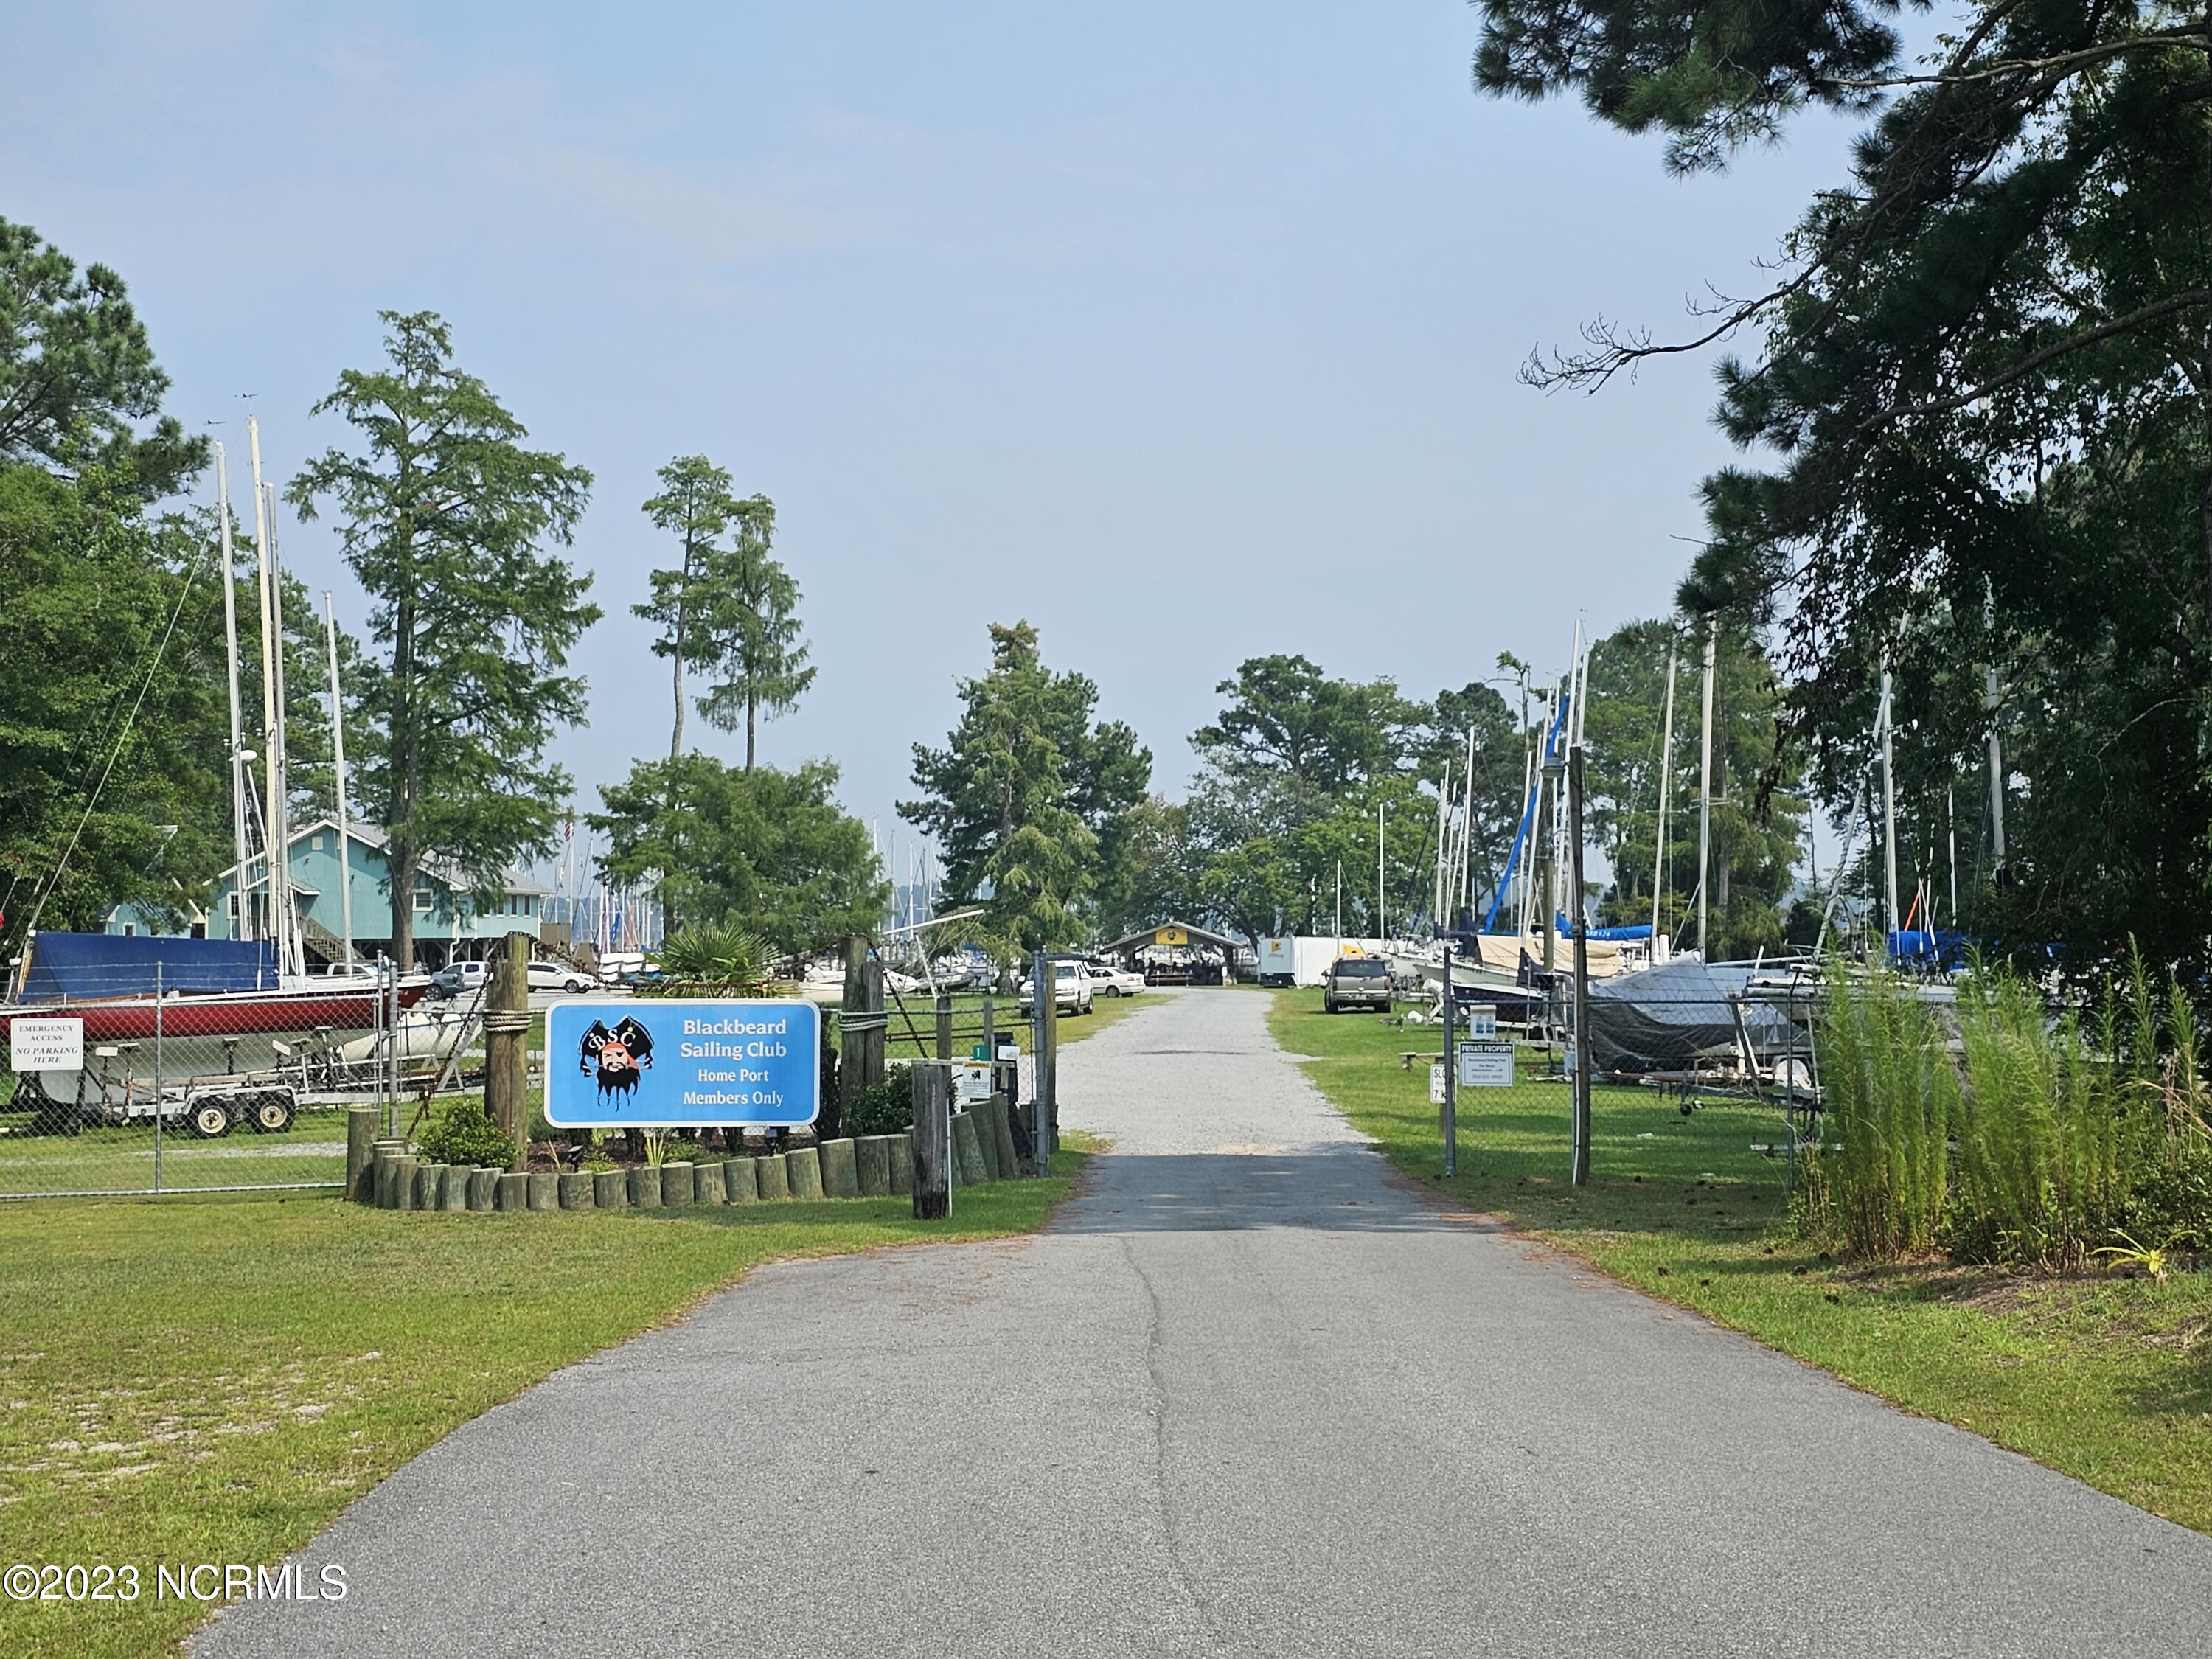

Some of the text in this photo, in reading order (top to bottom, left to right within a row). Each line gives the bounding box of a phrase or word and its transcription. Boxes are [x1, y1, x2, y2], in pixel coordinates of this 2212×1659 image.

[684, 1019, 787, 1034] Blackbeard
[588, 1029, 636, 1051] BSC
[681, 1041, 787, 1060] Sailing Club
[698, 1069, 769, 1082] Home Port
[684, 1090, 783, 1107] Members Only
[1434, 1090, 1439, 1099] 7
